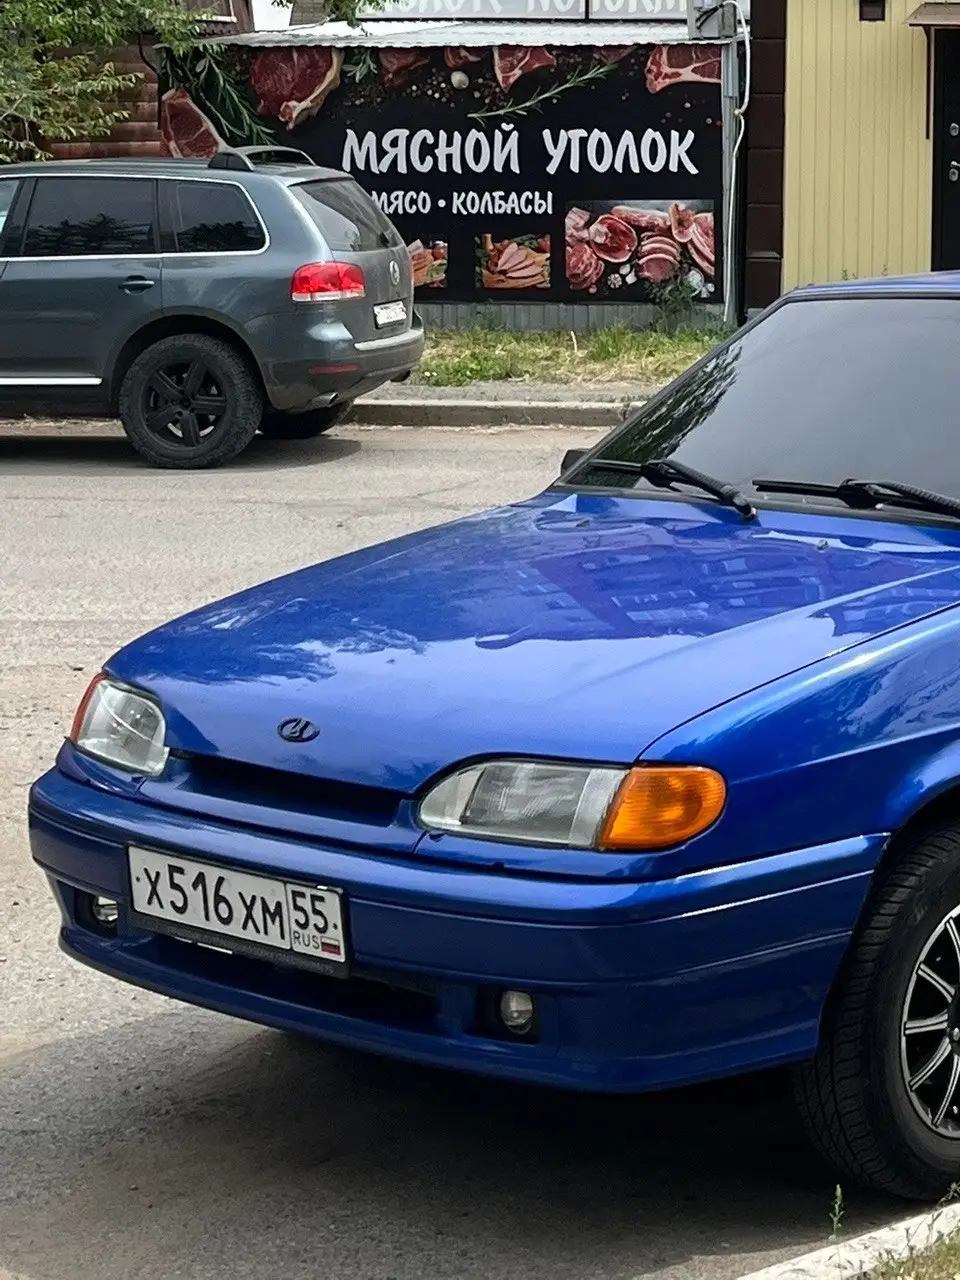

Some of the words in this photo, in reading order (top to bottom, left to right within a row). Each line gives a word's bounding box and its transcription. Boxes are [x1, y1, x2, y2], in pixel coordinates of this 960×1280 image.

[341, 122, 521, 175] МЯСНОЙ
[542, 127, 699, 175] УГОЛОК
[371, 190, 432, 215] МЯСО
[452, 191, 553, 215] КОЛБАСЫ
[293, 929, 320, 950] RUS
